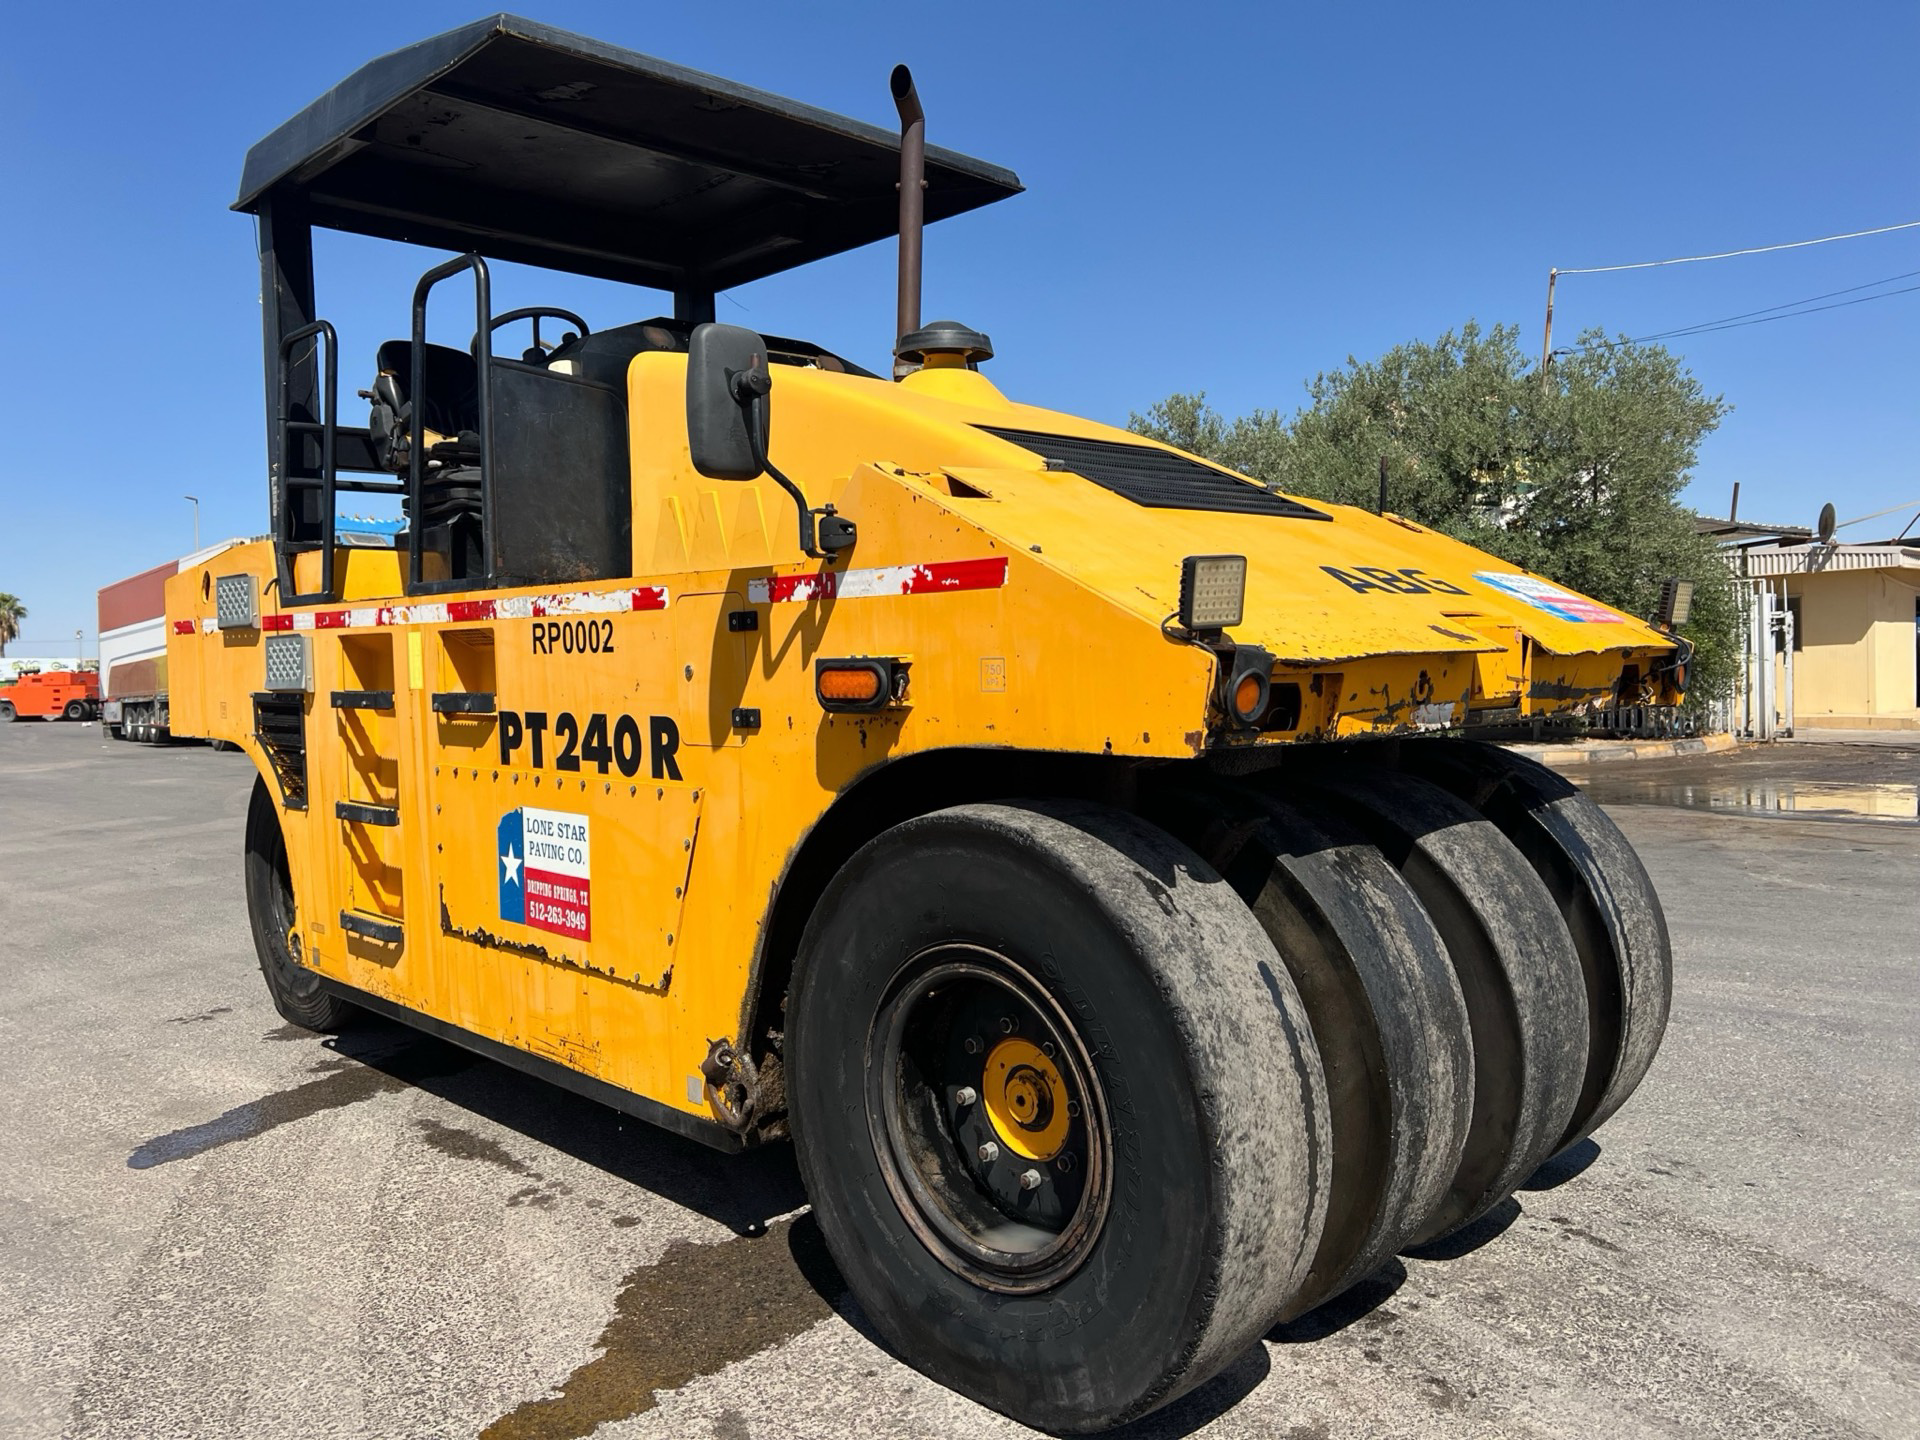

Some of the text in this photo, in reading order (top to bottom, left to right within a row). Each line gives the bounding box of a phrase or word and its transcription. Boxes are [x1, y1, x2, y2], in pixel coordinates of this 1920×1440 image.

[1319, 565, 1473, 596] ABG
[532, 619, 615, 655] RP0002
[526, 817, 587, 842] LONE STAR
[529, 840, 586, 865] PAVING CO.
[527, 879, 588, 907] DRIPPING SPRINGS, TX
[530, 901, 587, 931] 512-263-3949
